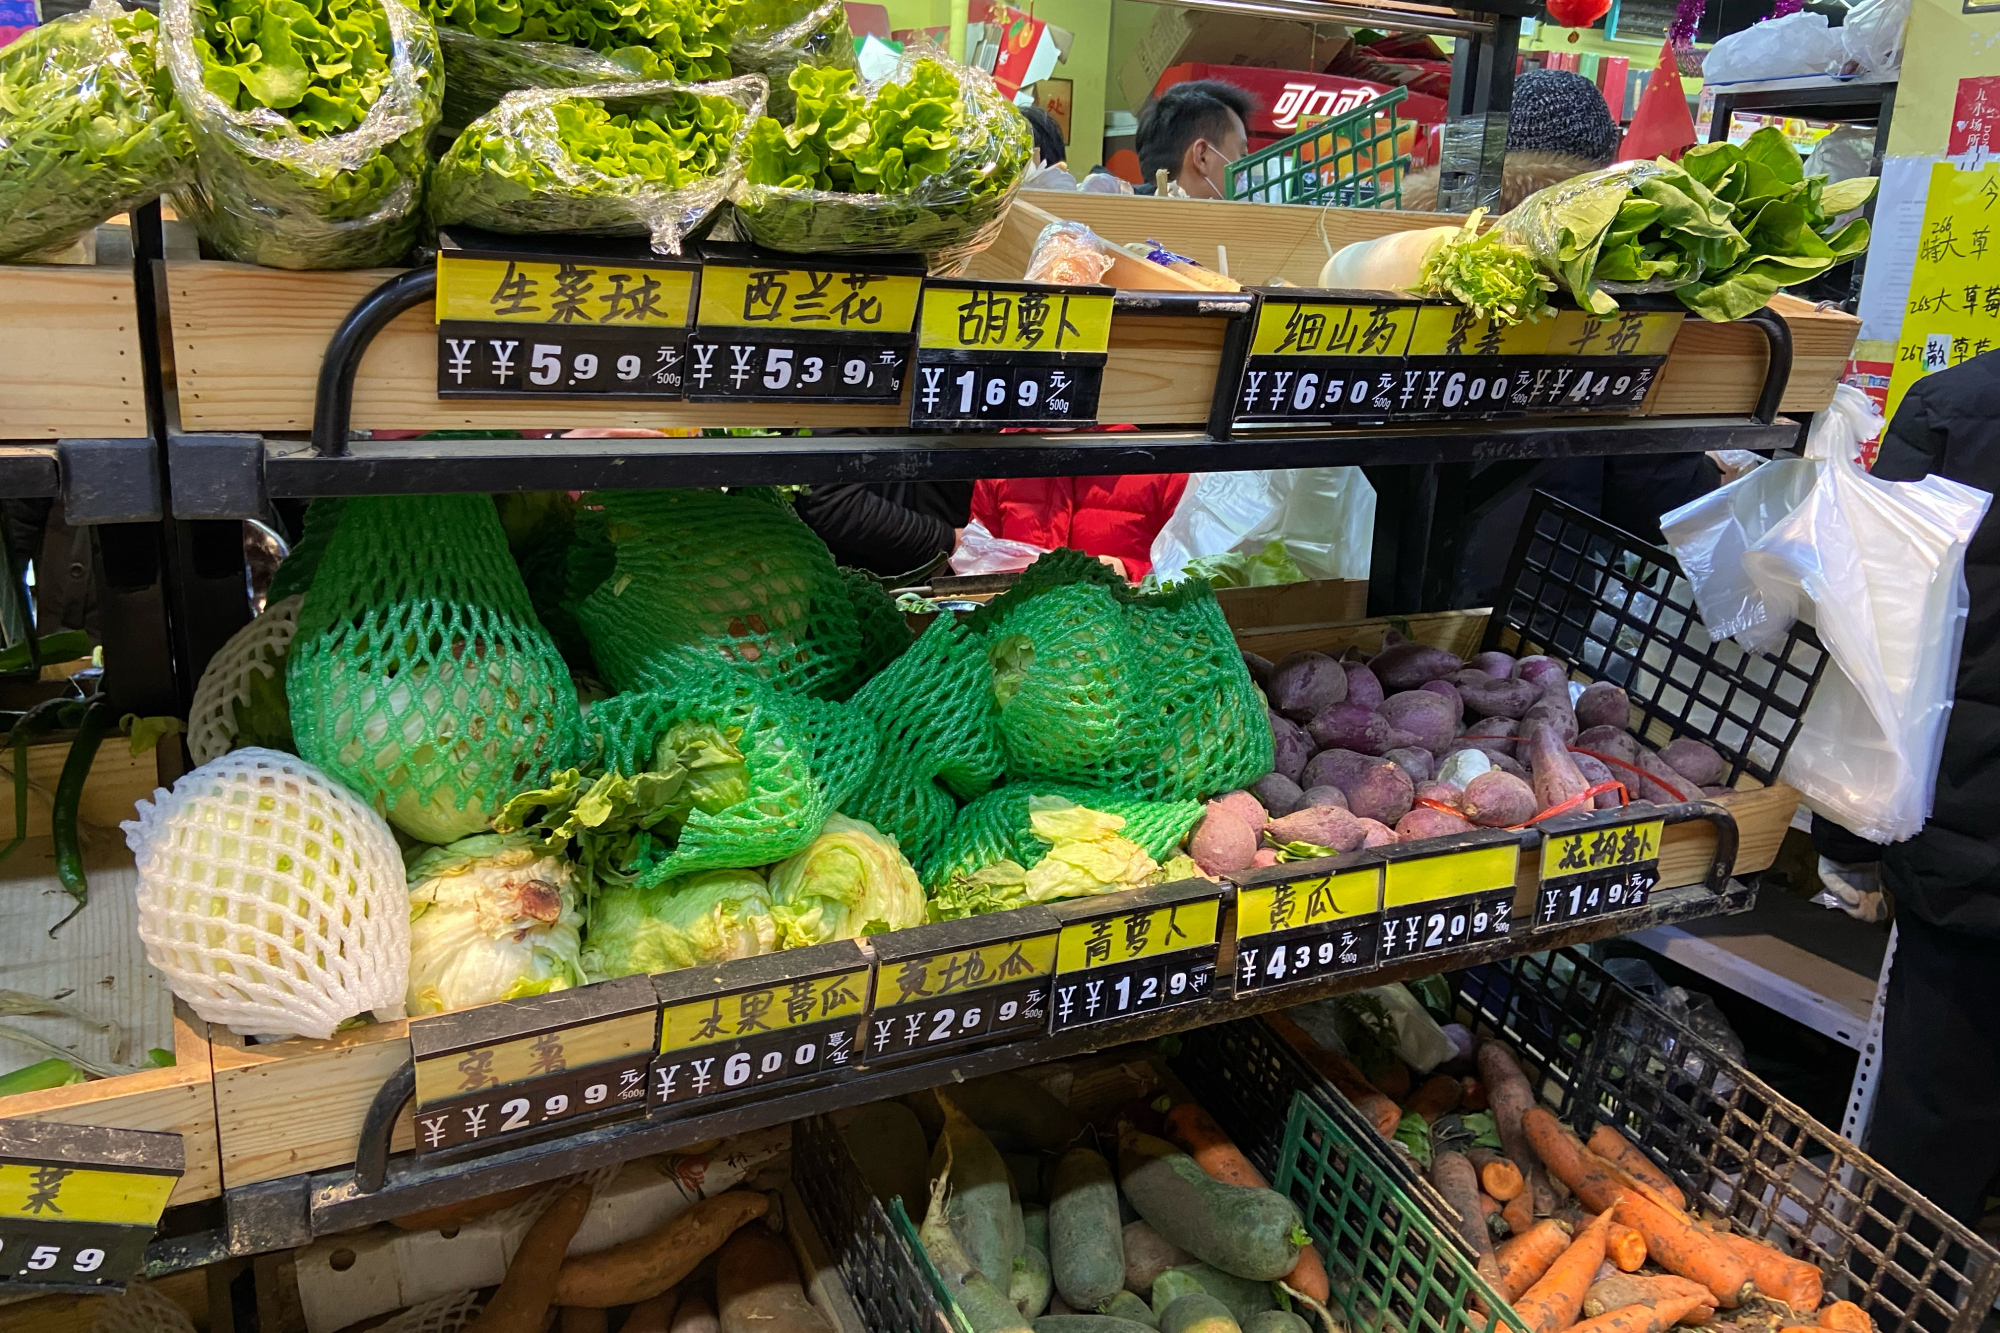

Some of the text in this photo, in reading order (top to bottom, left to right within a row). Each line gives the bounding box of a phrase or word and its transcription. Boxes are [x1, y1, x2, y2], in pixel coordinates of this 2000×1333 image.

[1932, 215, 1953, 234] 266
[743, 270, 888, 325] 西兰花
[958, 290, 1081, 350] 胡萝卜
[1274, 303, 1400, 355] 细山药
[1269, 877, 1343, 931] 黄瓜
[1084, 905, 1187, 968] 青萝卜
[689, 976, 860, 1041] 水果黄瓜
[0, 1238, 106, 1275] .59
